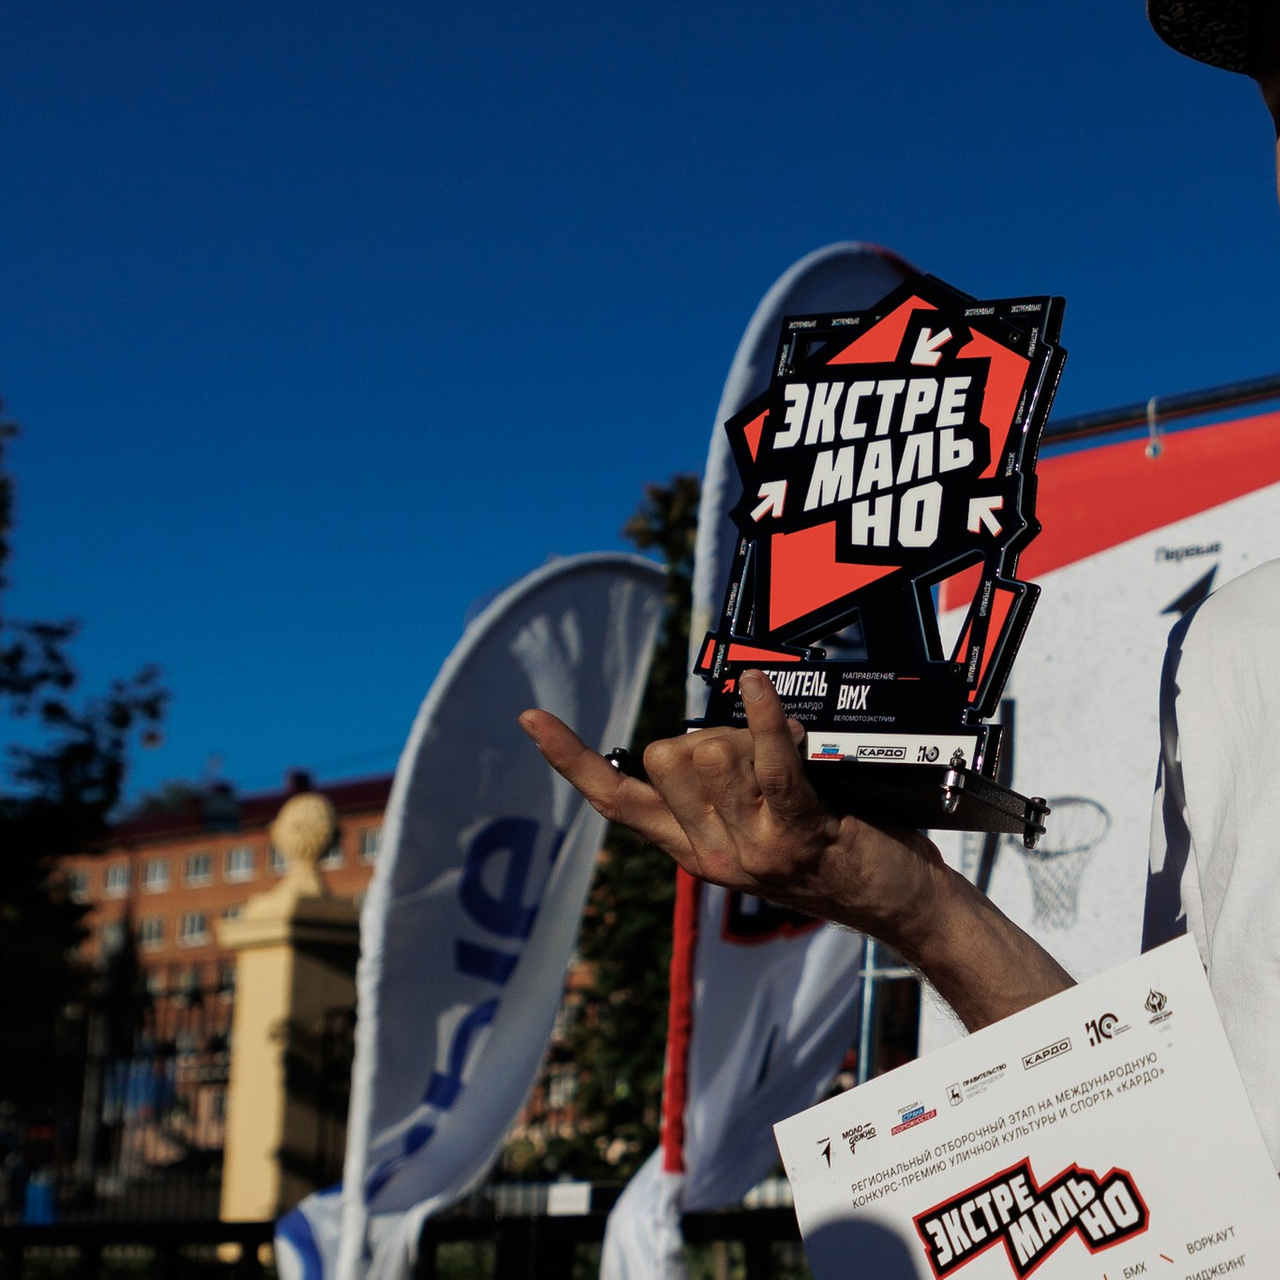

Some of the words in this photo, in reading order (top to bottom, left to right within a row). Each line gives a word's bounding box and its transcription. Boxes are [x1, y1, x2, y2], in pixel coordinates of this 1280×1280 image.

[773, 376, 972, 449] ЭКСТРЕ
[803, 428, 975, 511] МАЛЬ
[851, 480, 943, 548] НО
[738, 670, 829, 697] ЕДИТЕЛЬ
[798, 702, 824, 711] КАРДО
[842, 672, 896, 680] НАПРАВЛЕНИЕ
[858, 749, 904, 758] КАРДО
[962, 1063, 1007, 1087] ПРАВИТЕЛЬСТВО
[1024, 1040, 1070, 1067] КАРДО
[851, 1150, 933, 1194] РЕГИОНАЛЬНЫЙ
[934, 1116, 1006, 1158] ОТБОРОЧНЫЙ
[1008, 1105, 1036, 1125] ЭТАП
[1038, 1097, 1054, 1112] НА
[1055, 1052, 1158, 1104] МЕЖДУНАРОДНУЮ
[852, 1161, 947, 1209] КОНКУРС-ПРЕМИЮ
[949, 1135, 1001, 1168] УЛИЧНОЙ
[1002, 1113, 1057, 1145] КУЛЬТУРЫ
[1059, 1107, 1069, 1118] И
[1070, 1087, 1114, 1114] СПОРТА
[1116, 1067, 1165, 1094] «КАРДО»
[925, 1172, 1039, 1268] ЭКСТРЕ
[1008, 1178, 1098, 1268] МАЛЬ
[1079, 1180, 1140, 1242] НО
[1184, 1226, 1237, 1256] ВОРКАУТ
